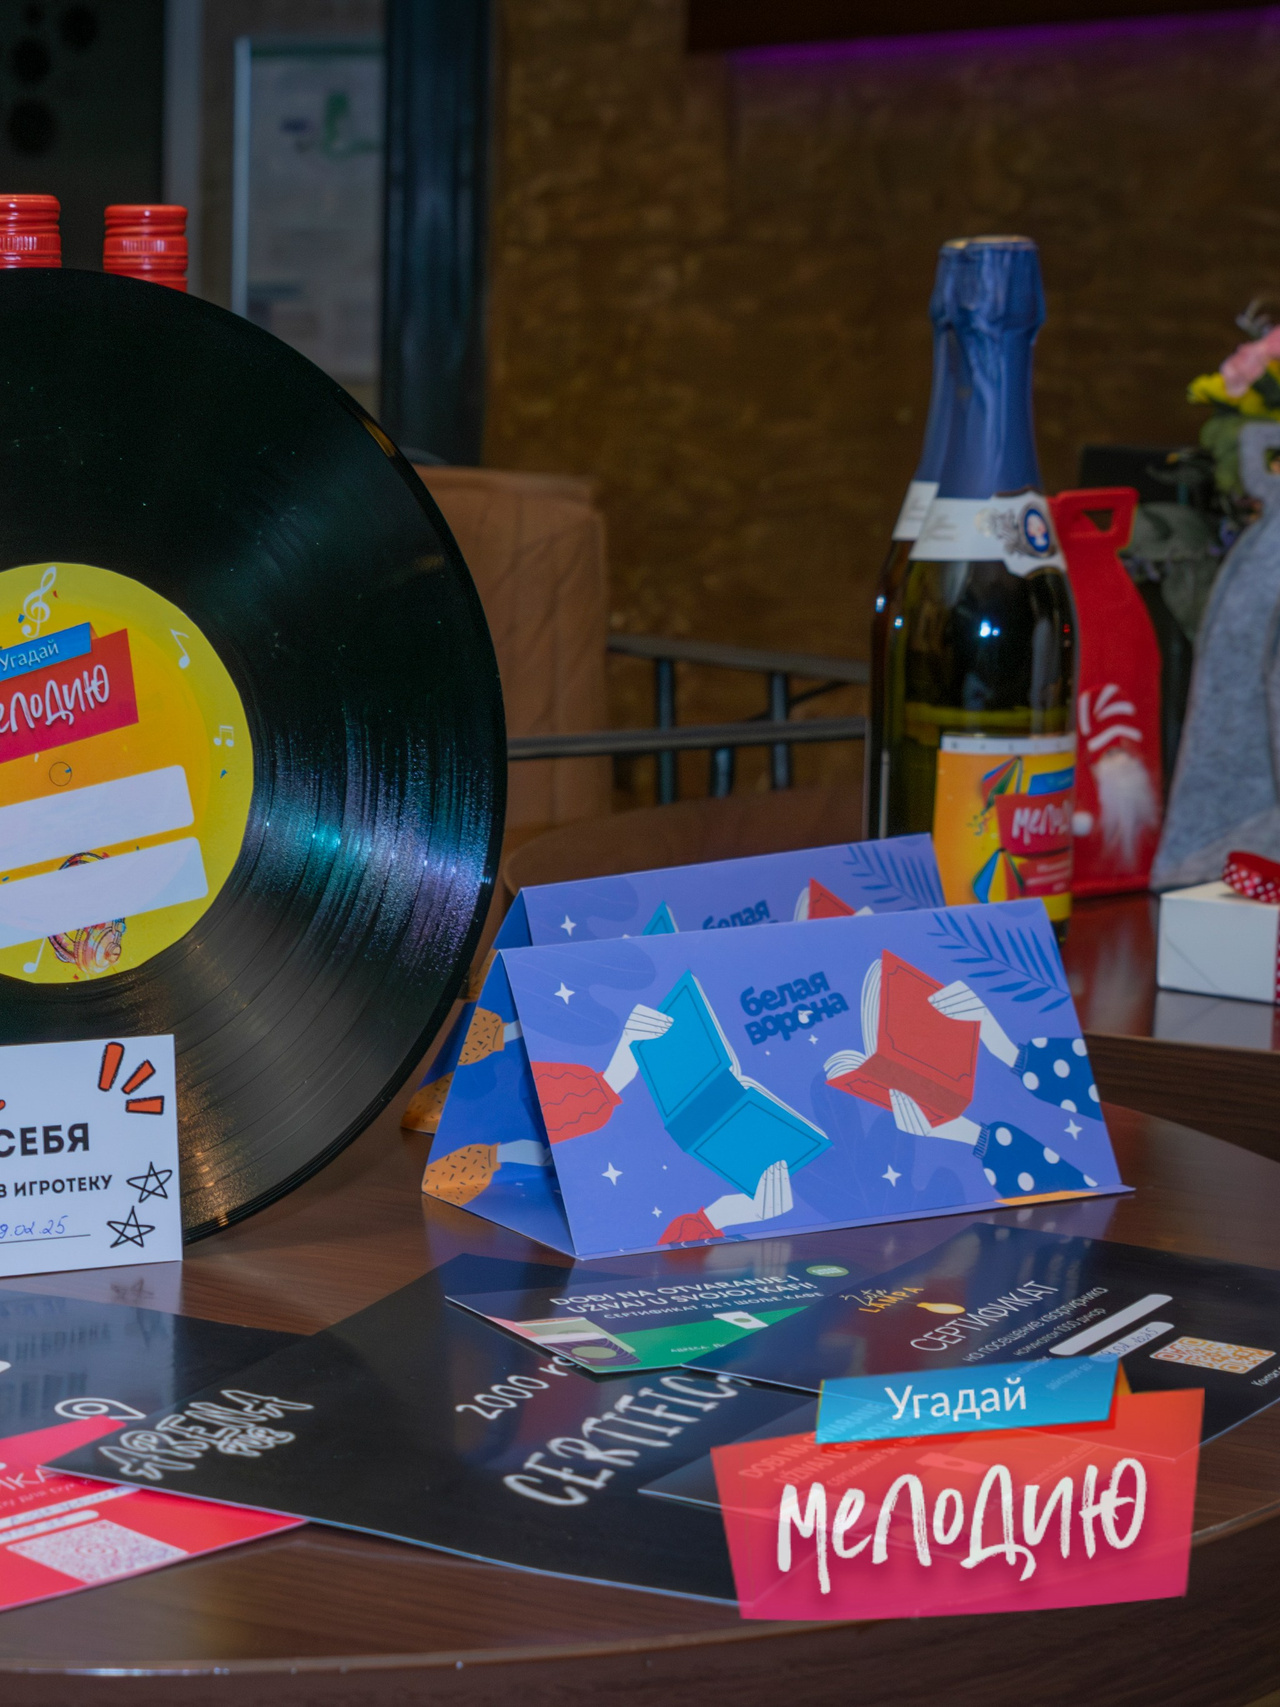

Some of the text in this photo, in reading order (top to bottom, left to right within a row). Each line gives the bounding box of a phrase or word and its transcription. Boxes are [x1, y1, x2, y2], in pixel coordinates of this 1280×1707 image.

[740, 971, 831, 1016] белая
[743, 989, 850, 1046] ворона
[14, 1175, 113, 1198] ИГРОТЕКУ
[618, 1289, 656, 1300] NA
[656, 1275, 786, 1294] OTVARANJE
[648, 1296, 670, 1305] U
[670, 1288, 756, 1303] SVOJOJ
[759, 1281, 818, 1294] KAFI!
[858, 1286, 924, 1313] LAMPA
[603, 1305, 699, 1320] СЕРТИФИКАТ
[910, 1280, 1059, 1352] СЕРТИФИКАТ
[978, 1318, 1044, 1357] посещение
[455, 1374, 551, 1421] 2000
[503, 1375, 751, 1506] CERTIFIC
